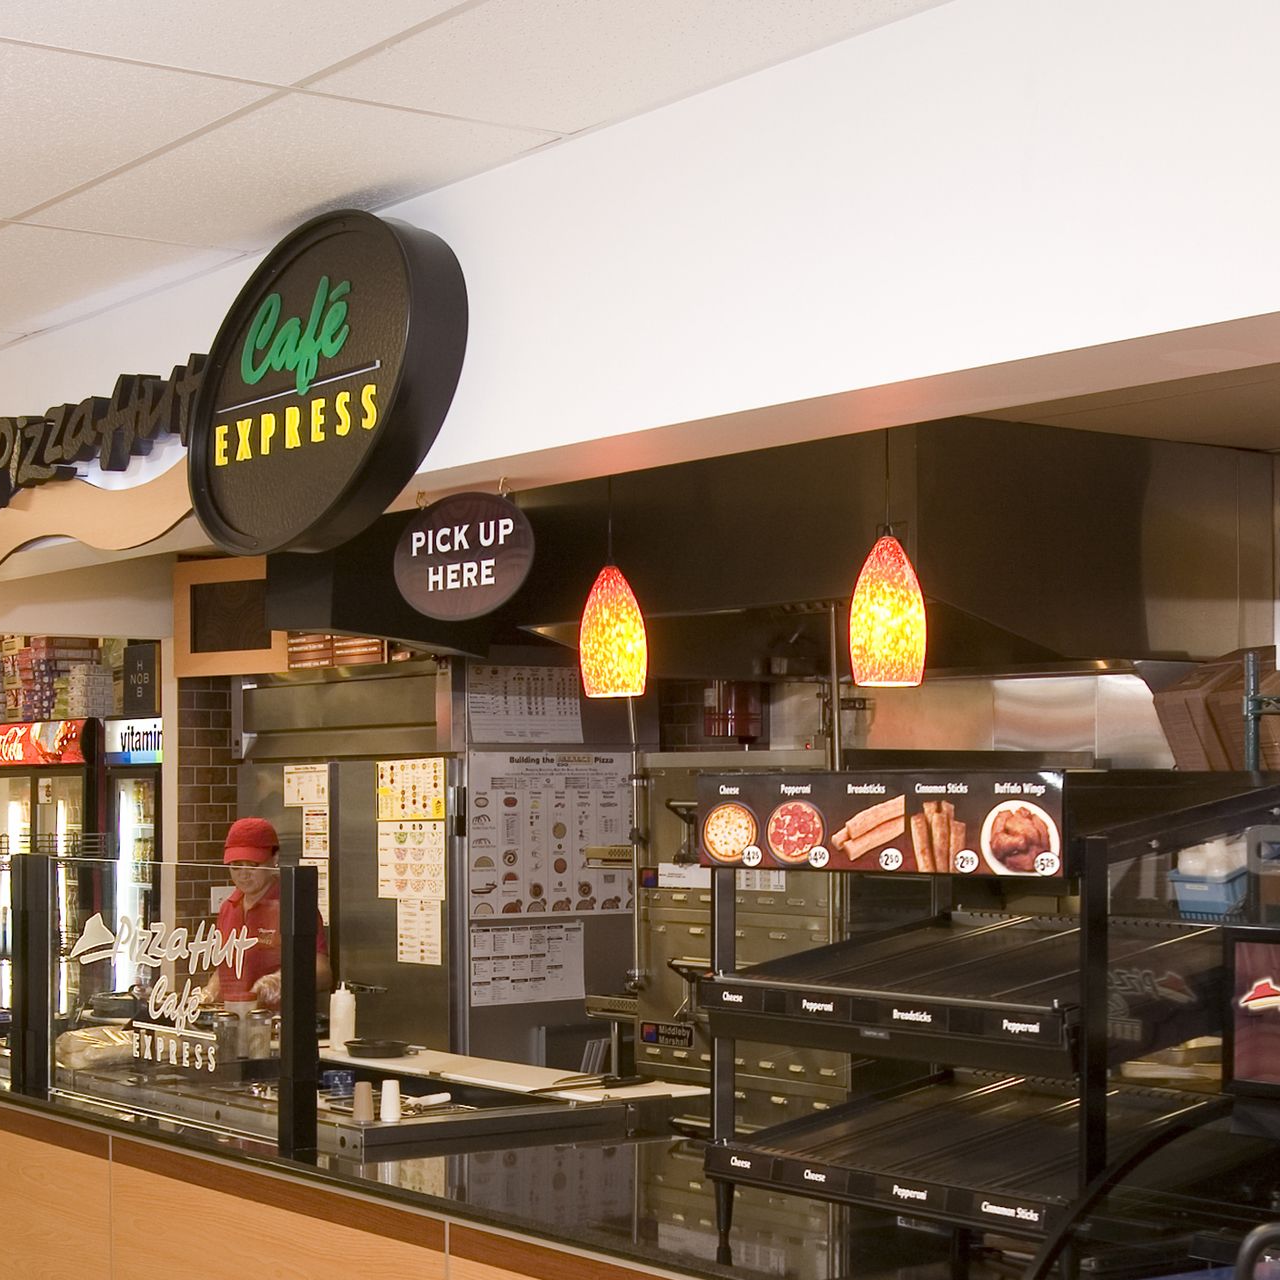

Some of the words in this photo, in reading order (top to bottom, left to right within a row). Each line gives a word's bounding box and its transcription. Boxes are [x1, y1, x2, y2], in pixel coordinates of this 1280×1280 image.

[241, 276, 351, 395] Café
[214, 384, 380, 467] EXPRESS
[410, 524, 470, 557] PICK
[479, 517, 514, 546] UP
[428, 560, 495, 593] HERE
[130, 673, 149, 685] NOB
[510, 756, 540, 765] Building
[719, 784, 740, 796] Cheese
[780, 783, 811, 796] Pepperoni
[847, 783, 886, 795] Breadsticks
[915, 783, 946, 794] Cinnamon
[947, 783, 968, 795] Sticks
[994, 783, 1022, 795] Buffalo
[1022, 783, 1046, 796] Wings
[112, 915, 188, 967] Pizza
[189, 920, 259, 979] Hut
[722, 992, 744, 1003] Cheese
[148, 975, 201, 1036] Café
[802, 999, 834, 1012] Pepperoni
[892, 1009, 932, 1023] Breadsticks
[659, 1025, 690, 1038] Middleby
[1002, 1019, 1040, 1033] Pepperoni
[132, 1029, 216, 1072] EXPRESS
[730, 1156, 751, 1169] Cheese
[804, 1169, 826, 1182] Cheese
[892, 1184, 928, 1200] Pepperoni
[981, 1201, 1016, 1218] Cinnamon
[1016, 1206, 1039, 1221] Sticks
